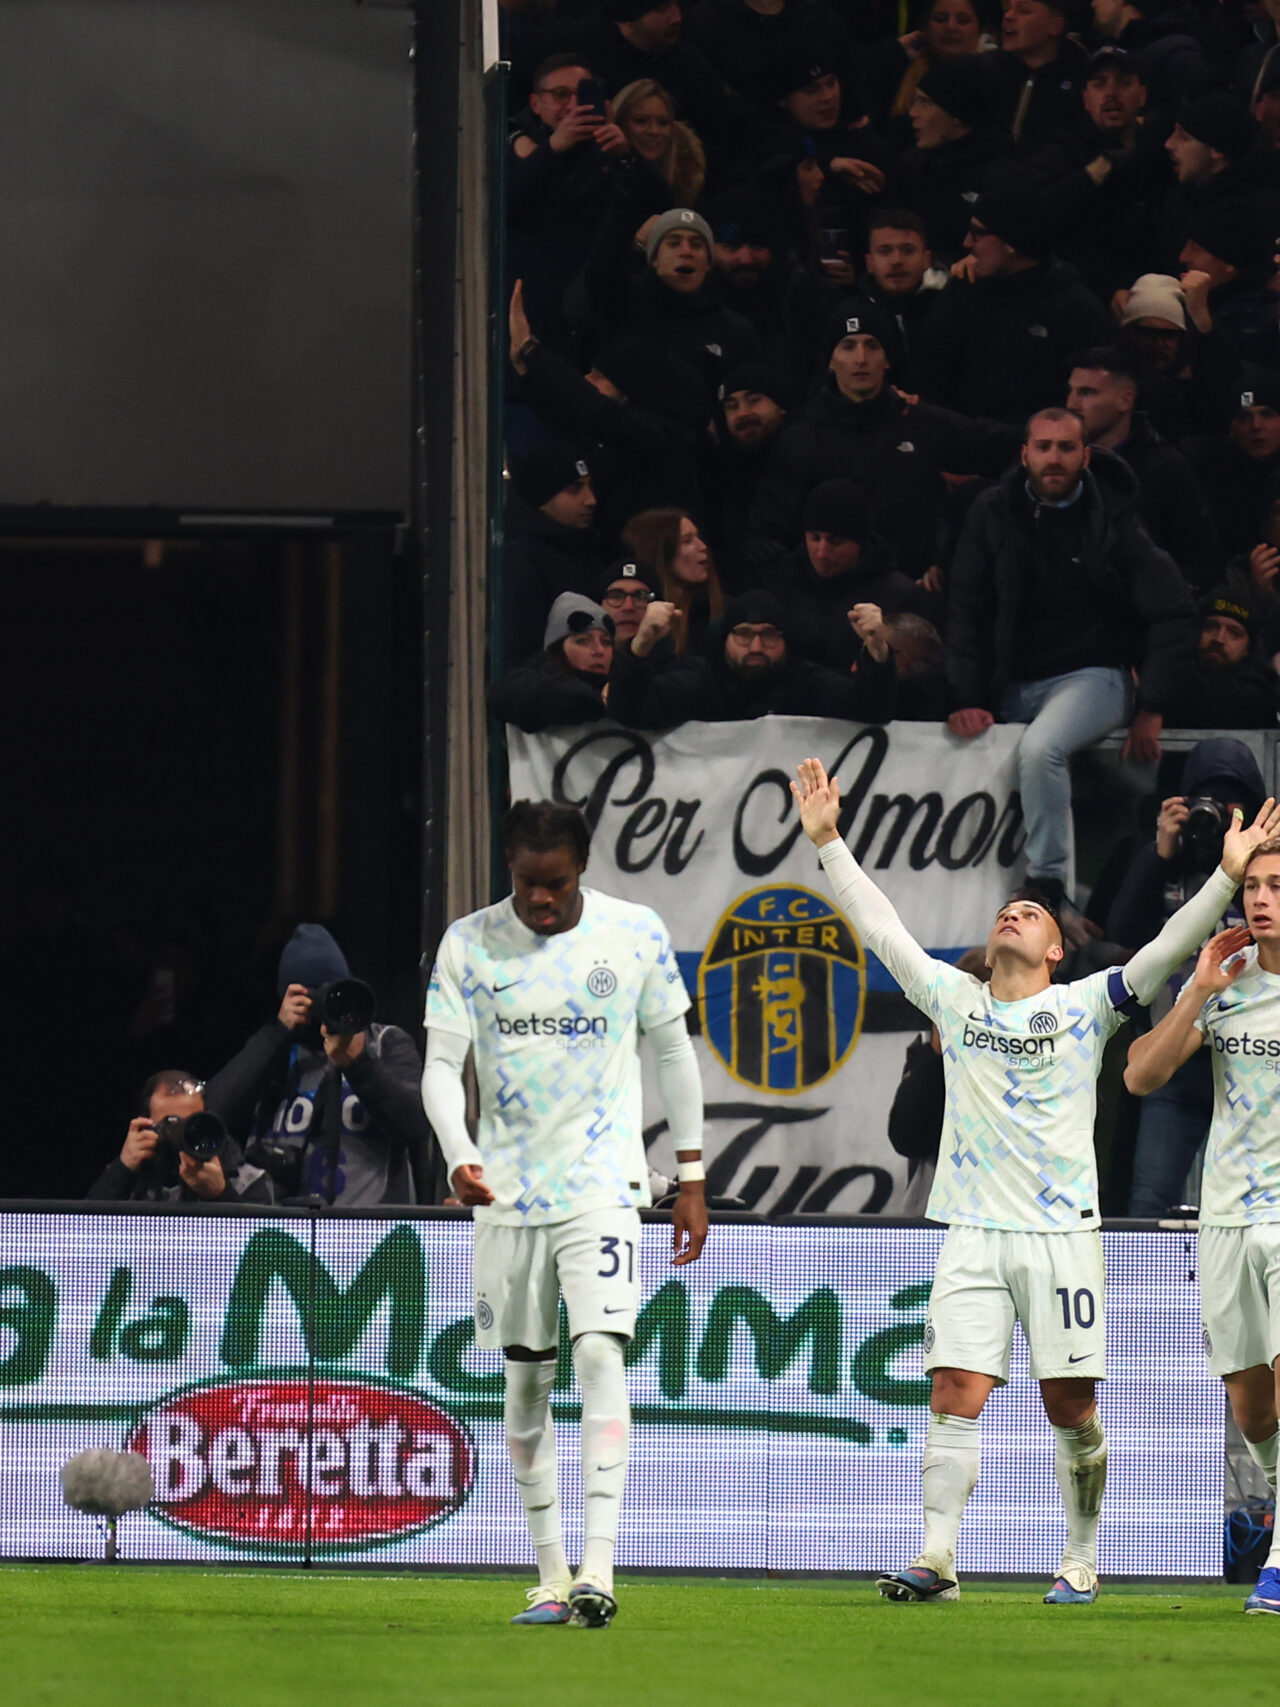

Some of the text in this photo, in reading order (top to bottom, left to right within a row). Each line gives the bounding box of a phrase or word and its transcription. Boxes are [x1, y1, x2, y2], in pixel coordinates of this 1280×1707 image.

[551, 728, 705, 876] Per
[732, 925, 840, 951] INTER
[495, 1012, 608, 1036] betsson
[962, 1023, 1056, 1055] betsson
[597, 1236, 634, 1284] 31
[90, 1266, 190, 1362] la
[1056, 1287, 1095, 1330] 10
[149, 1407, 458, 1502] Beretta
